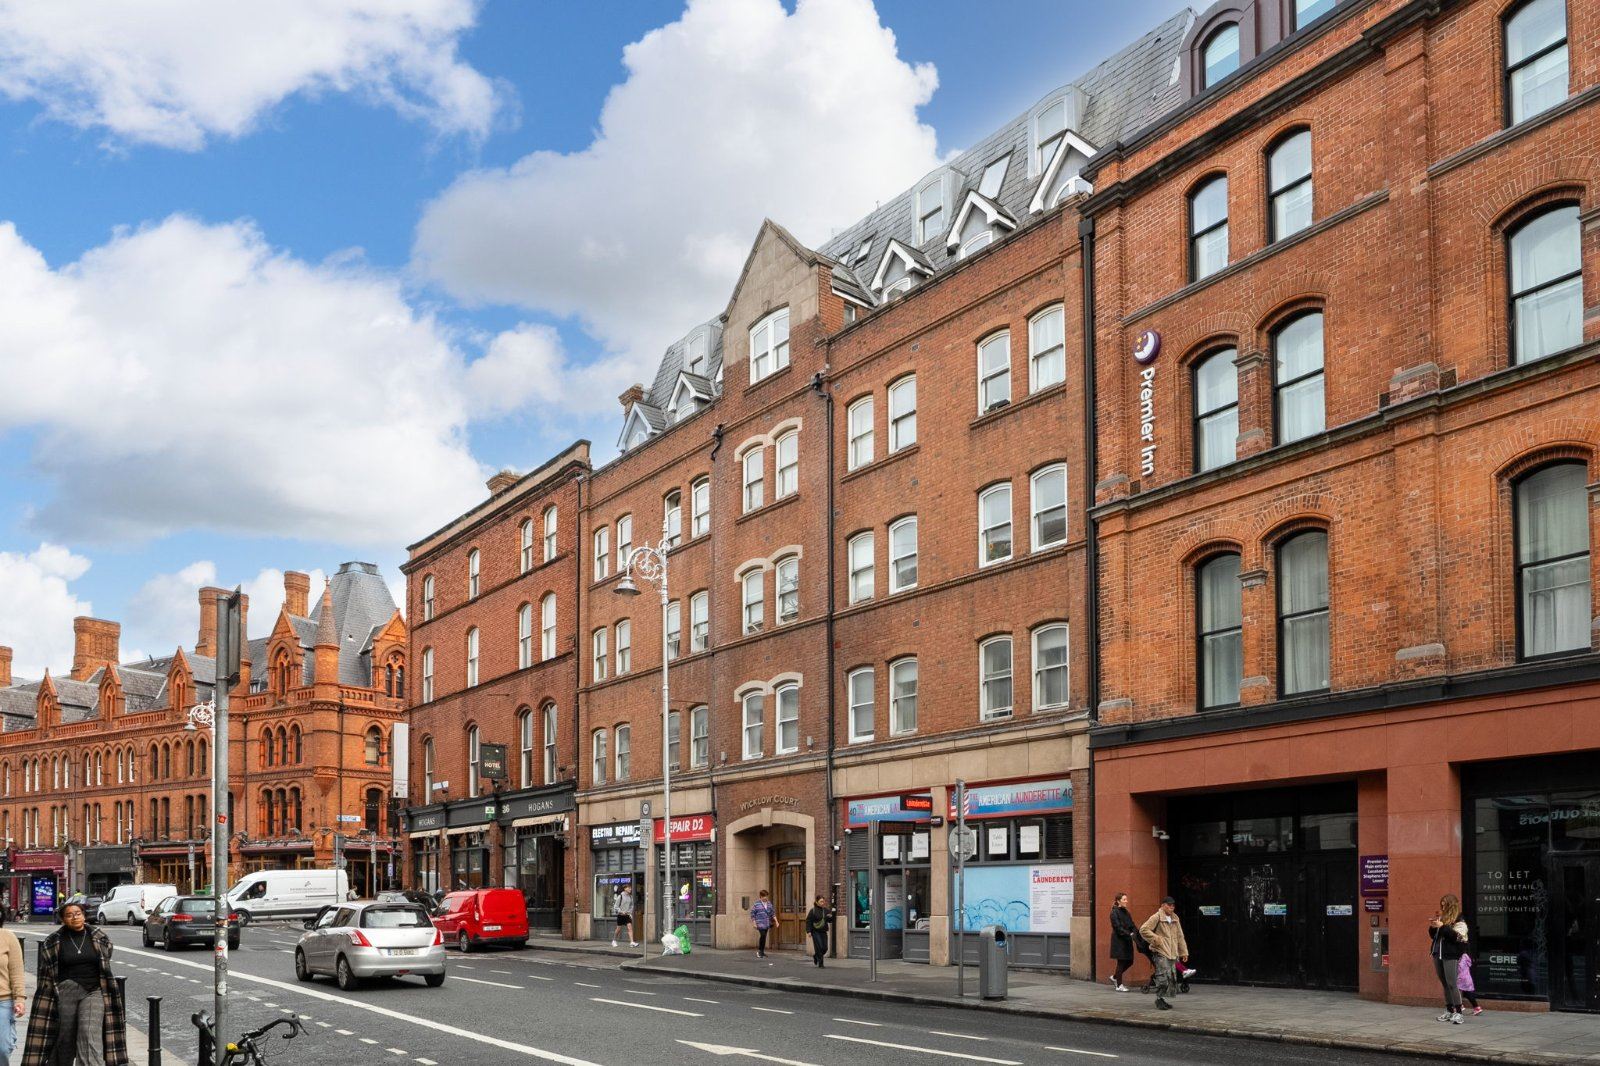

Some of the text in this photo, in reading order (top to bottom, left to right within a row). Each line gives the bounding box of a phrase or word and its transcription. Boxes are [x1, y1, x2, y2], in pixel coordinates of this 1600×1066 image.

[1140, 367, 1156, 476] Premier Inn
[978, 794, 1011, 806] AMERICAN
[1011, 787, 1061, 804] LAUNDERETTE
[528, 801, 554, 812] HOGANS
[740, 795, 800, 811] WICKLOW COURT
[418, 818, 436, 826] HOGANS
[692, 818, 704, 830] D2
[592, 827, 613, 838] ELECTRO
[1487, 870, 1530, 879] TO LET
[1489, 955, 1518, 964] CBRE
